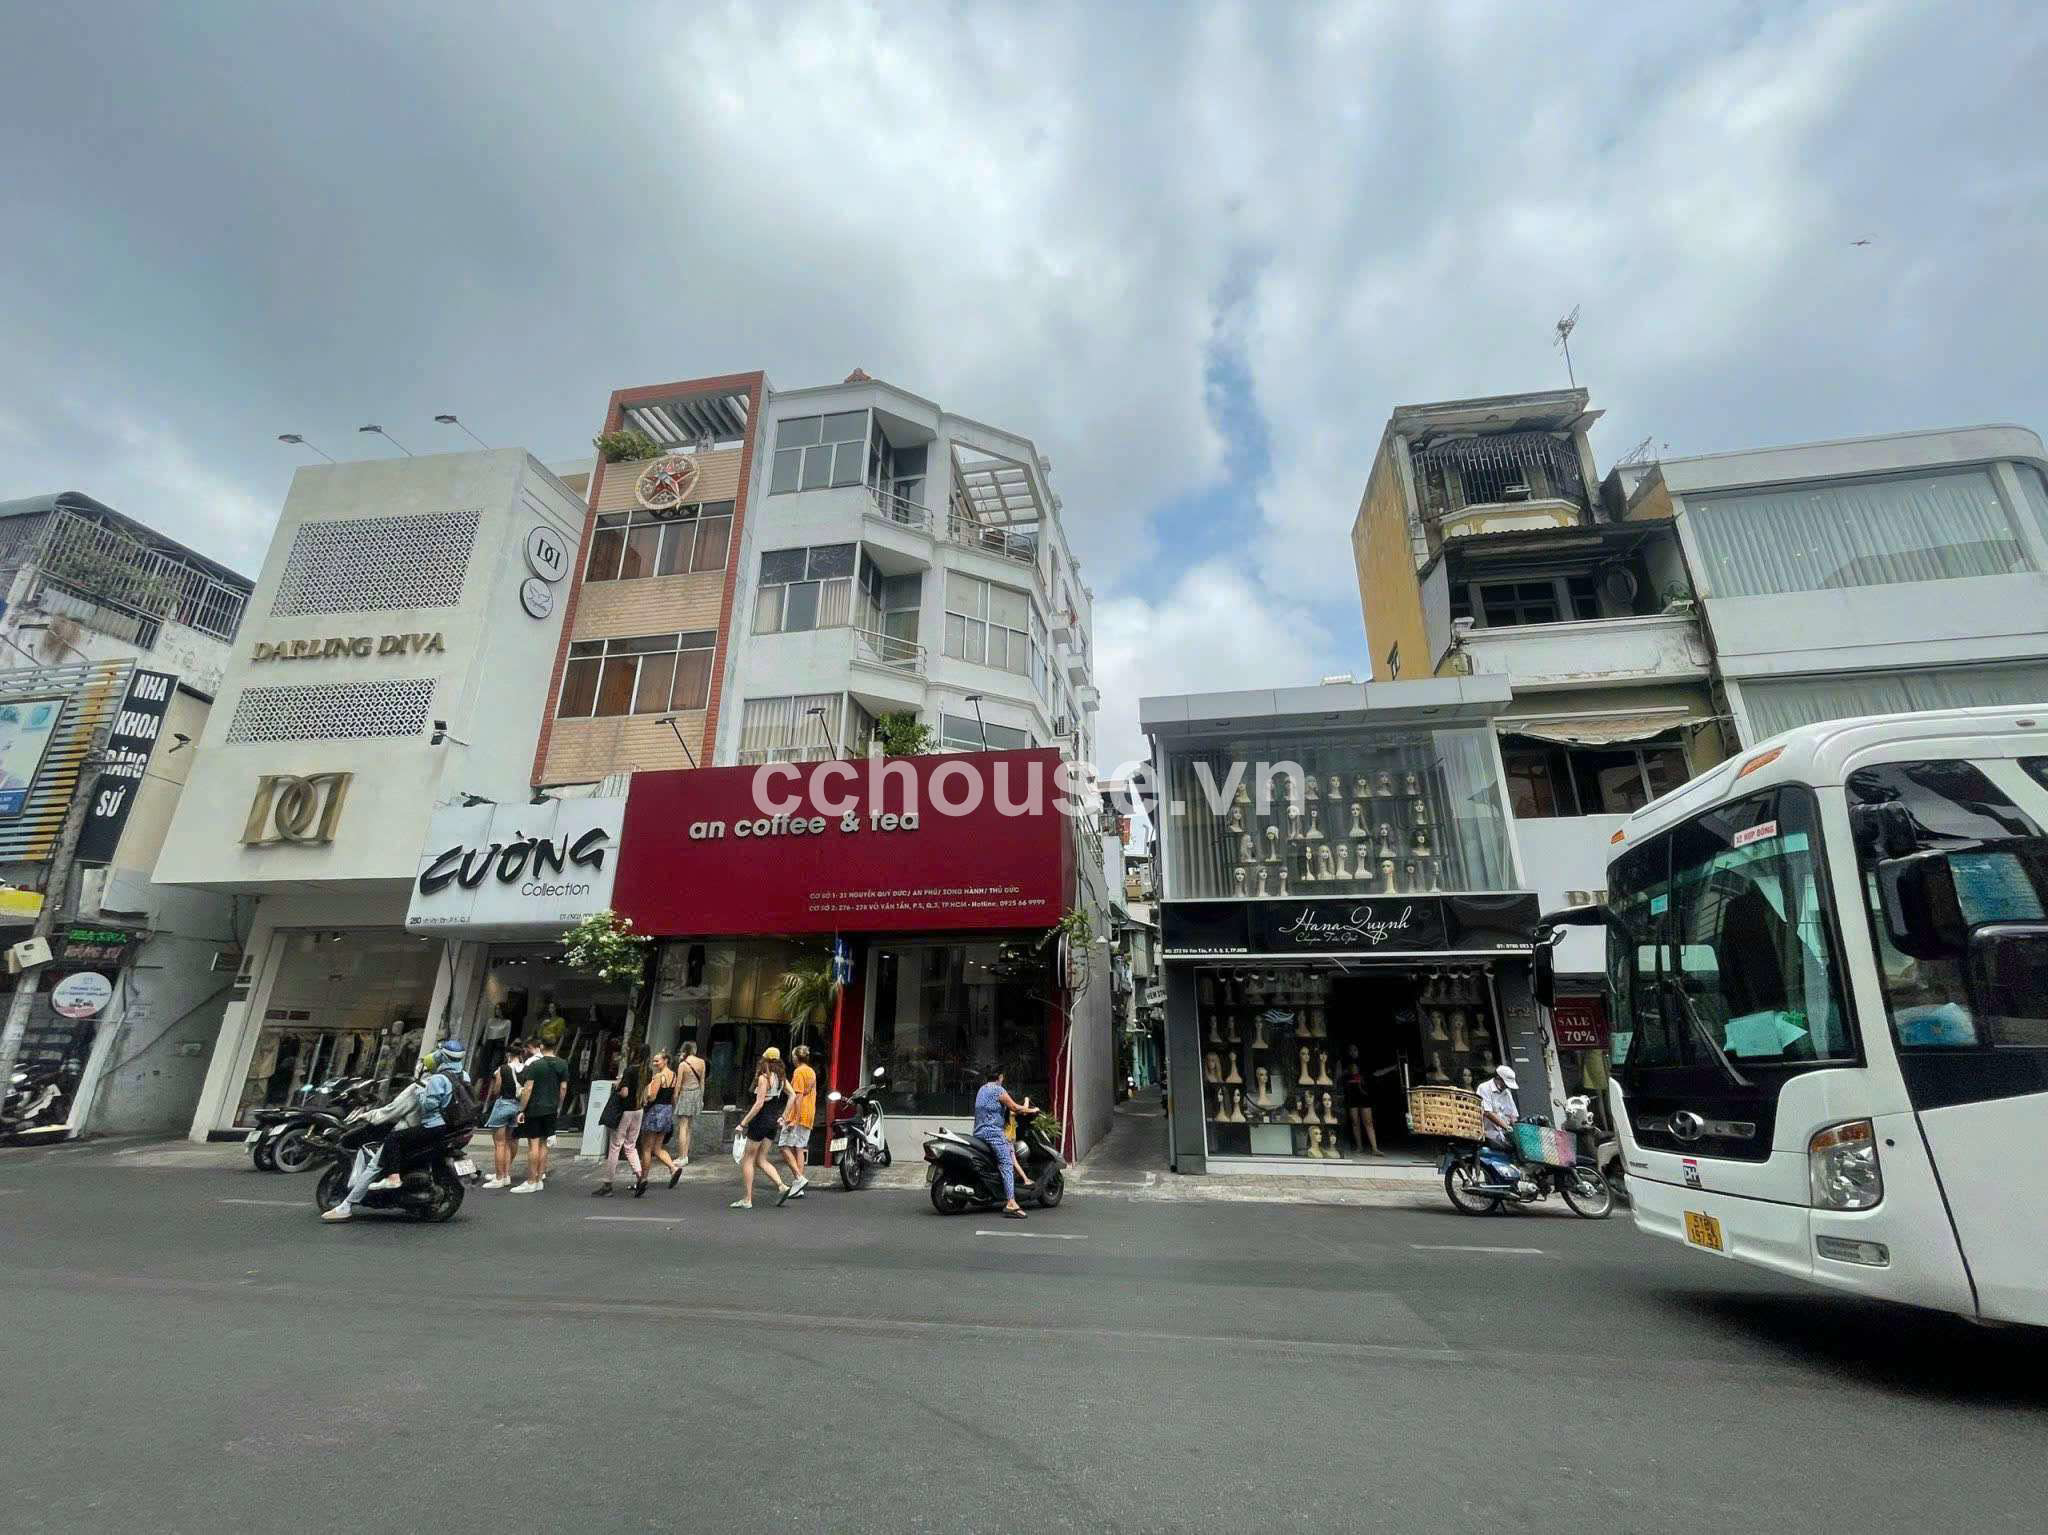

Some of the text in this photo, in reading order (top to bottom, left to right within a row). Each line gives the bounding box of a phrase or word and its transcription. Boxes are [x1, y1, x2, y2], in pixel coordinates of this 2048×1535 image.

[250, 632, 446, 661] DARLING DIVA
[134, 674, 169, 702] NHA
[115, 710, 160, 740] KHOA
[101, 746, 147, 778] RĂNG
[96, 784, 127, 818] SỨ
[689, 809, 920, 839] an coffee & tea
[419, 826, 611, 896] CƯỜNG
[520, 882, 590, 897] Collection
[1279, 907, 1346, 933] Hana
[1557, 1015, 1591, 1027] SALE
[1564, 1030, 1596, 1043] 70%
